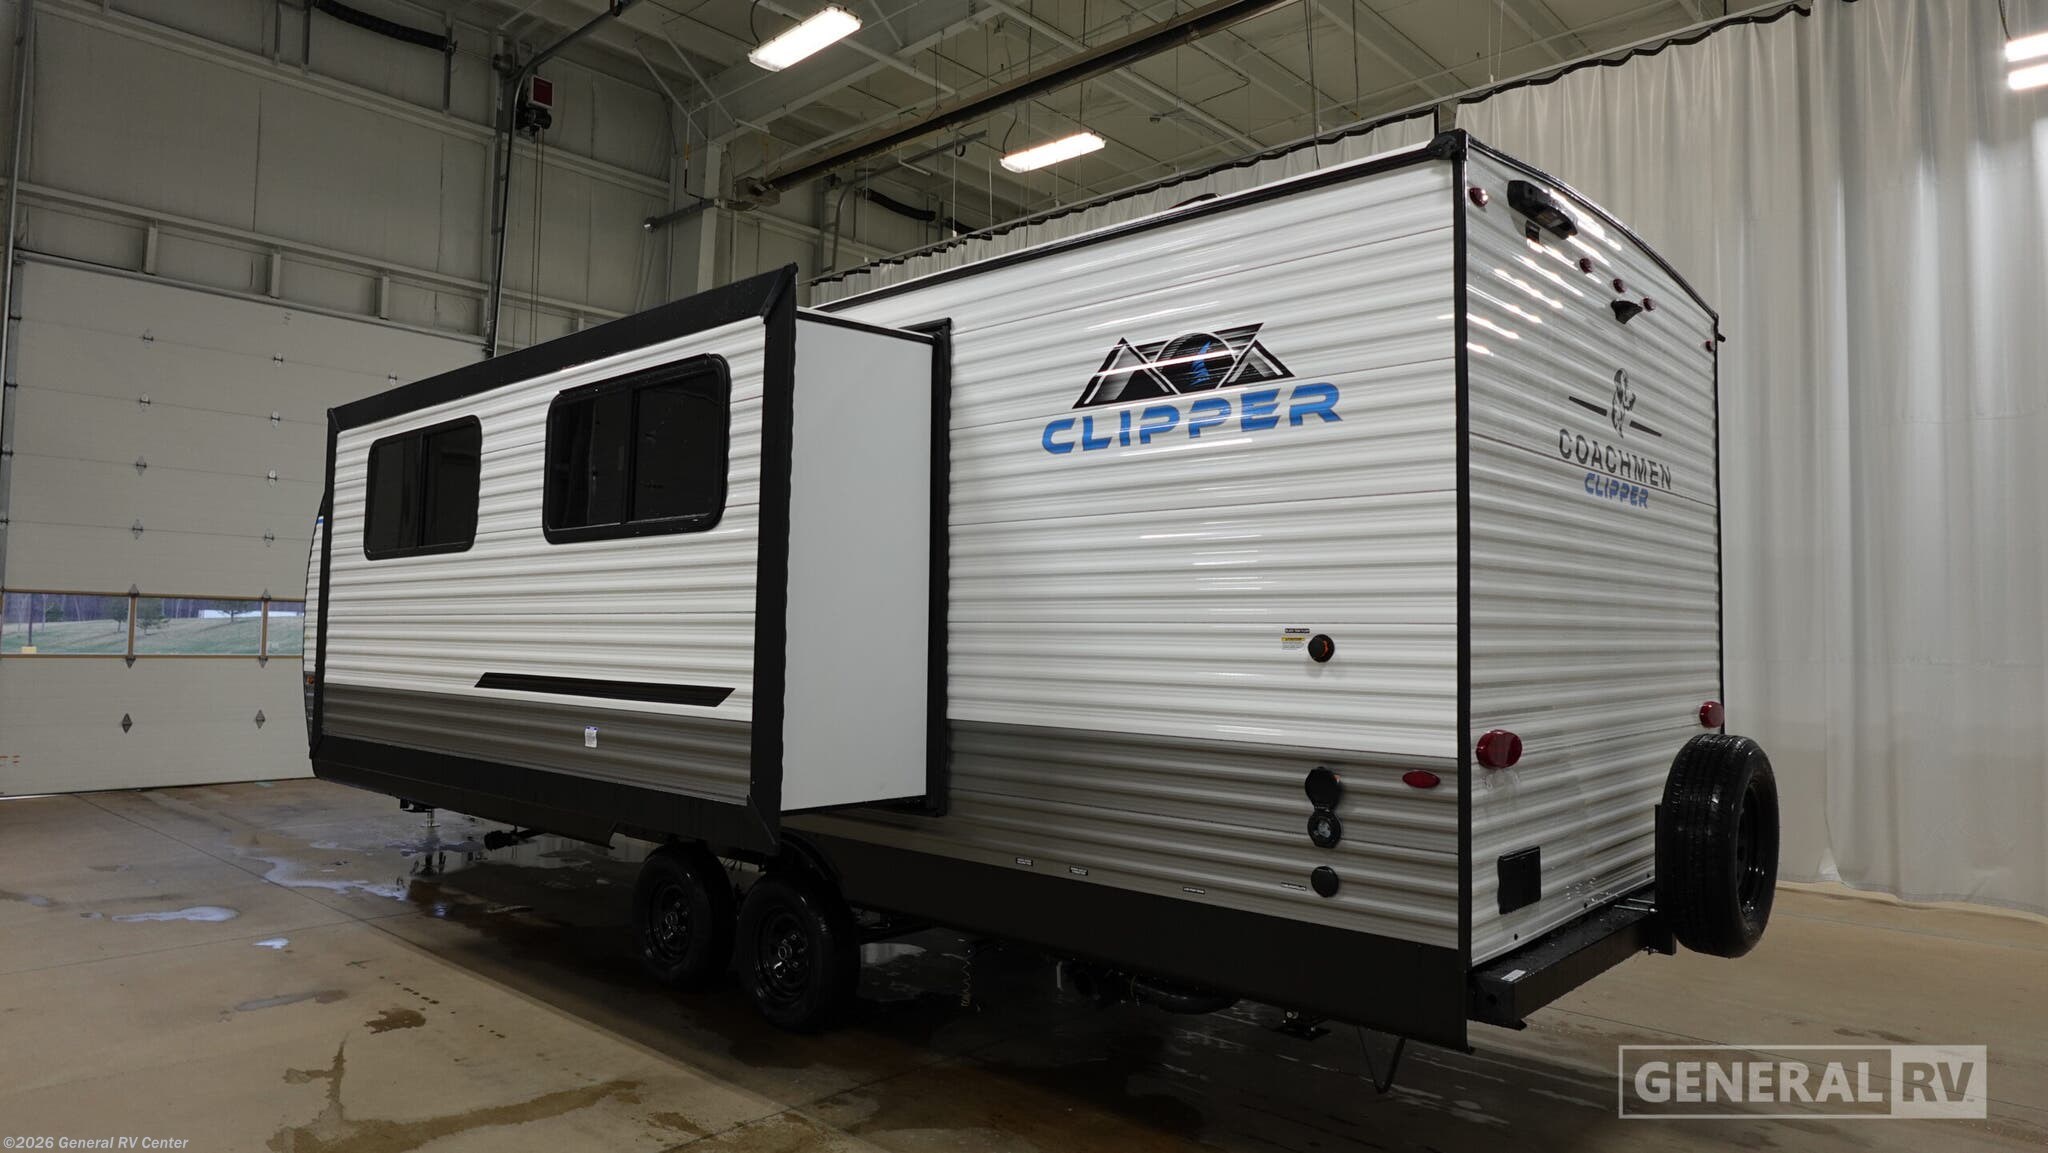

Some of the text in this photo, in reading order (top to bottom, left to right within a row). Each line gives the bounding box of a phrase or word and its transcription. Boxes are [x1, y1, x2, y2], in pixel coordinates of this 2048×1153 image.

[1041, 382, 1343, 455] CLIPPER
[1559, 428, 1672, 491] COACHMEN
[1584, 472, 1649, 509] CLIPPER
